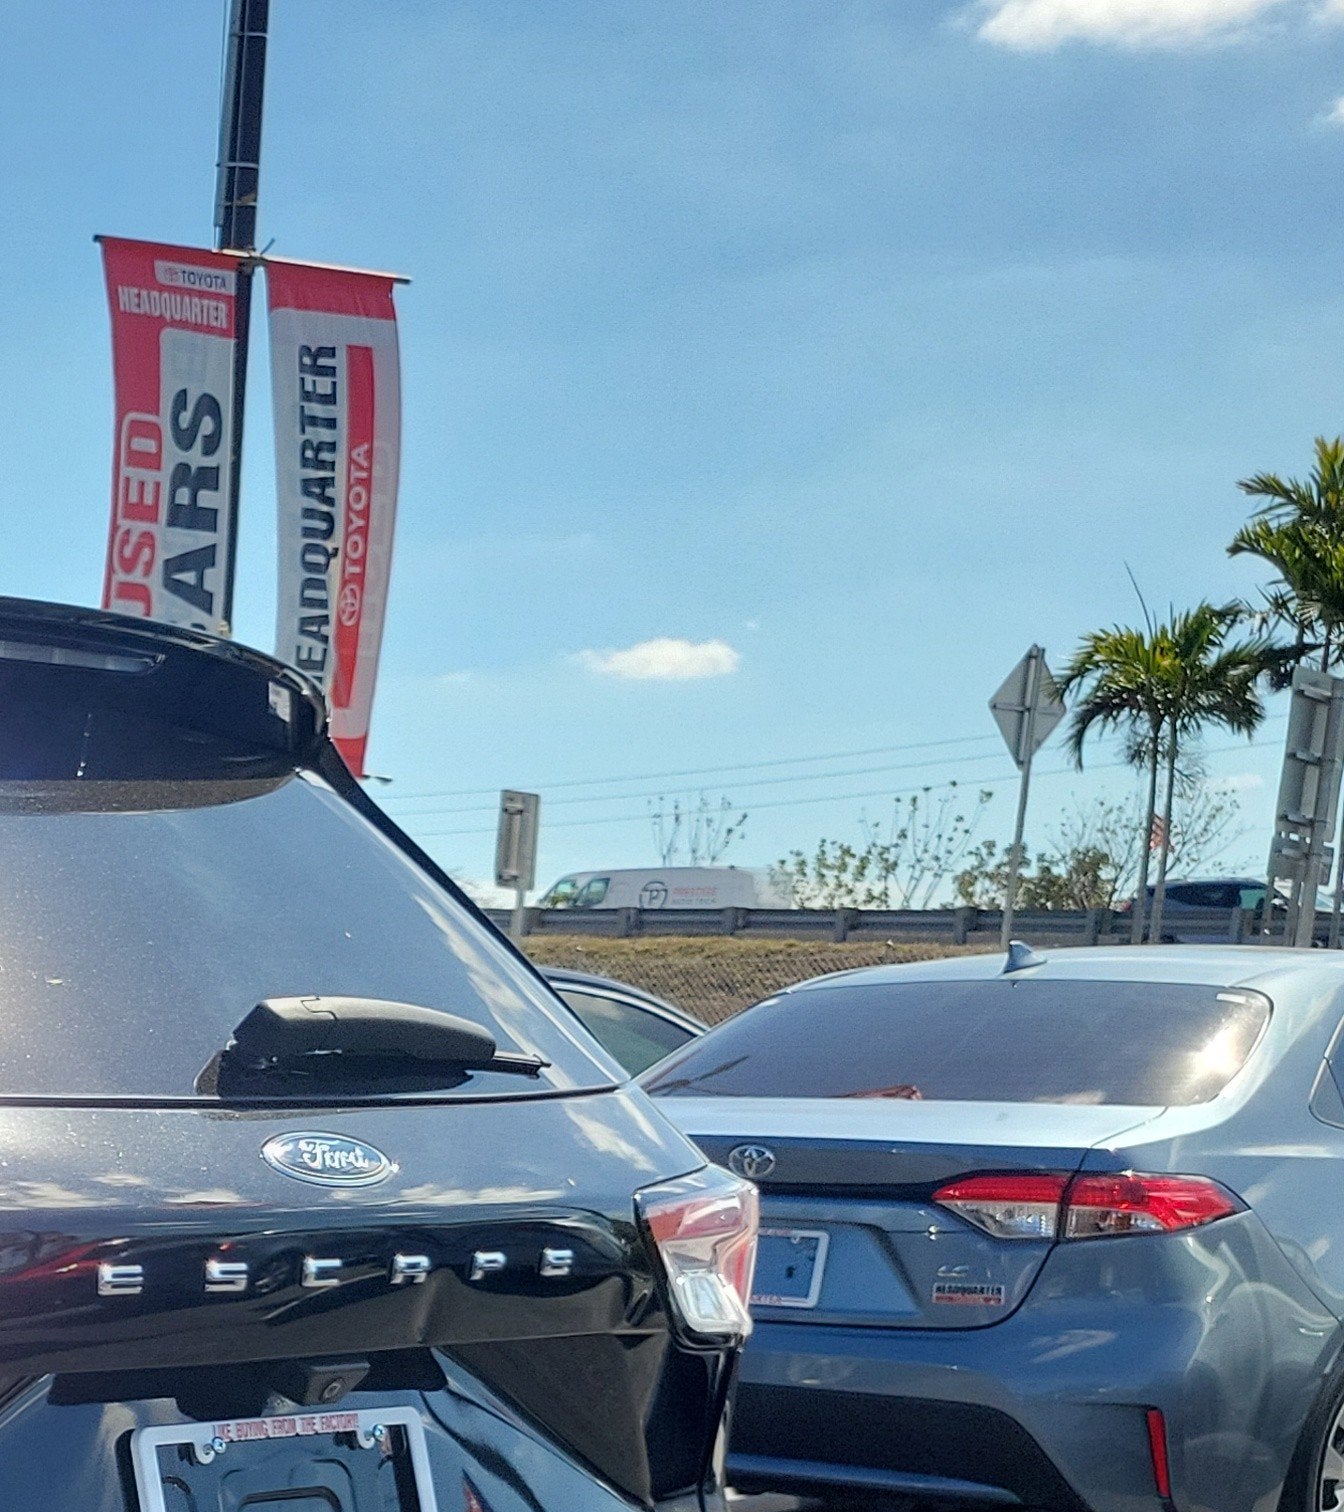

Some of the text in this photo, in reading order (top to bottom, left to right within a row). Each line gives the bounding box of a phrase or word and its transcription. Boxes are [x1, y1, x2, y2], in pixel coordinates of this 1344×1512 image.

[181, 270, 227, 290] TOYOTA
[118, 285, 228, 328] HEADQUARTER
[162, 388, 223, 631] ARS
[296, 345, 339, 684] EADQUARTER
[346, 443, 370, 575] TOYOTA
[297, 1139, 369, 1169] Ford
[97, 1247, 576, 1296] ESCAPE
[235, 1420, 269, 1439] BUYING
[271, 1417, 297, 1435] FROM
[299, 1416, 317, 1432] THE
